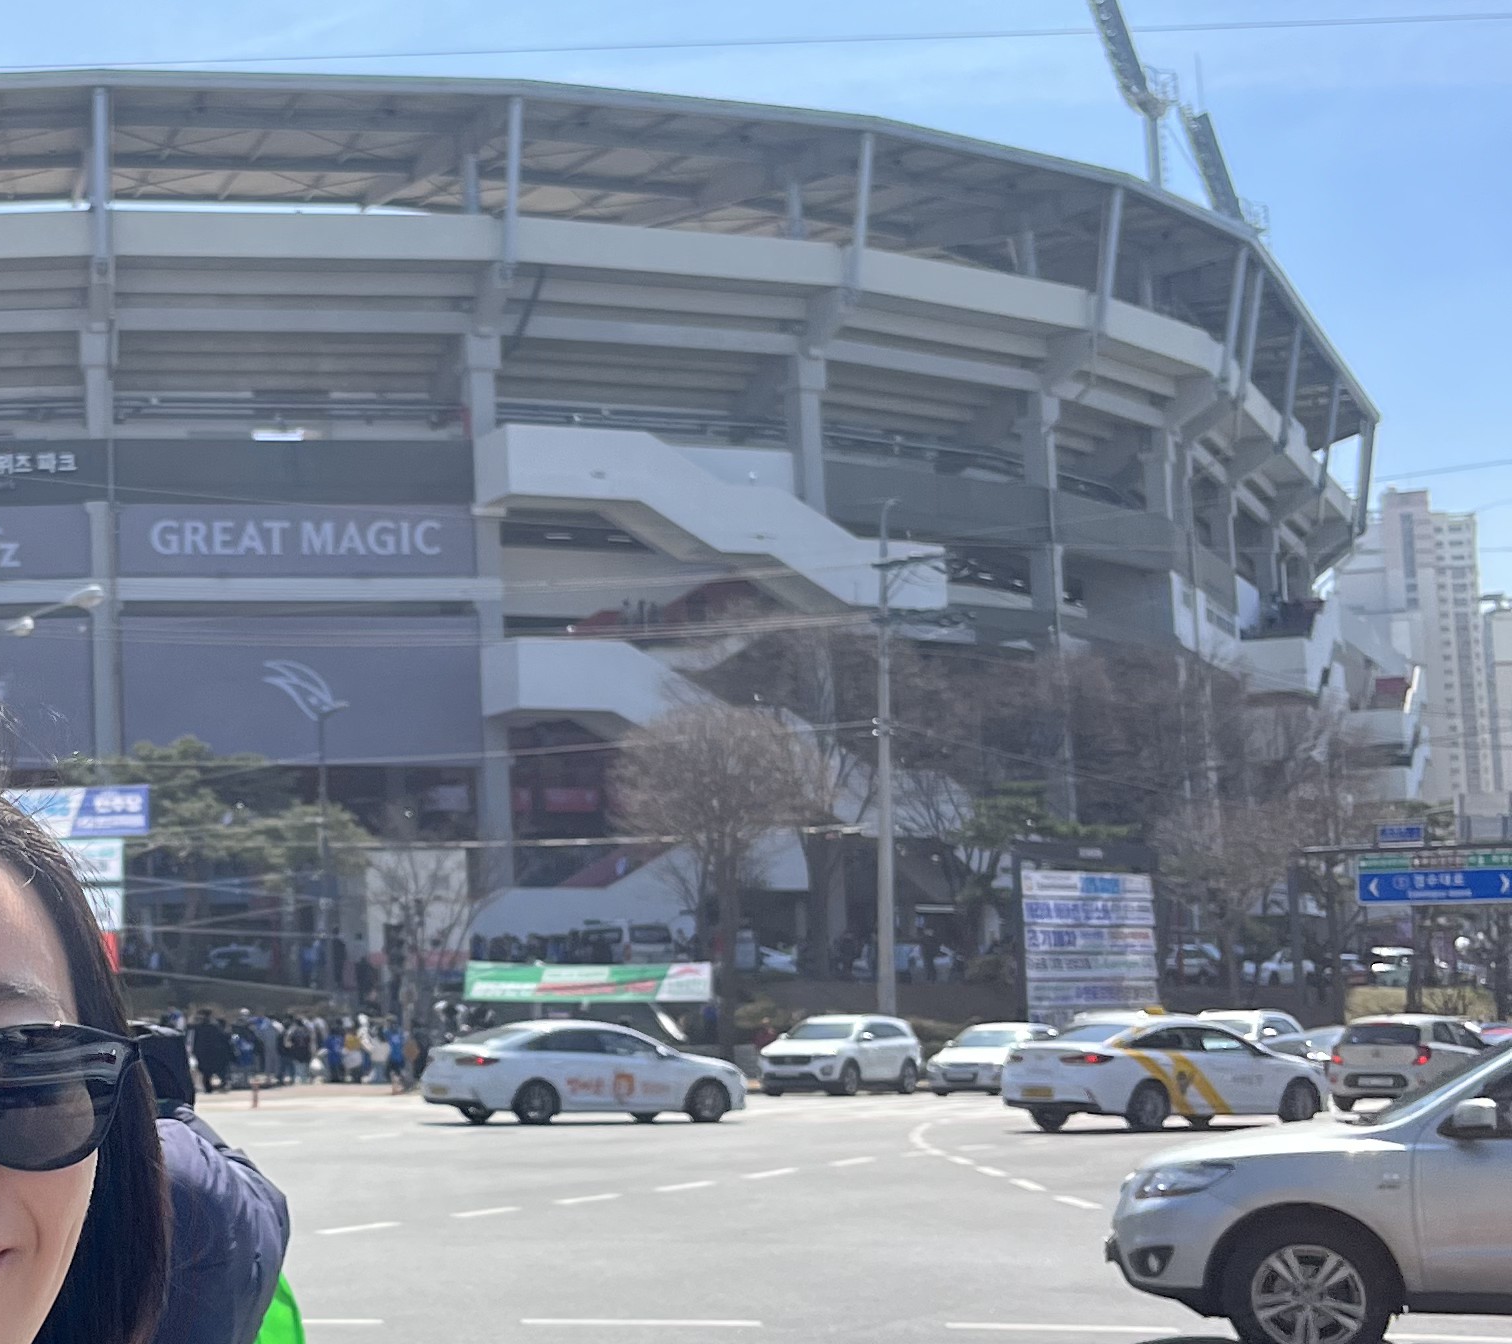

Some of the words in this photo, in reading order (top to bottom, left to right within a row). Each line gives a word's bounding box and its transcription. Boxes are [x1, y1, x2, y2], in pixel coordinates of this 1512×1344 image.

[38, 452, 78, 474] 파크
[150, 519, 290, 556] GREAT
[300, 519, 442, 556] MAGIC
